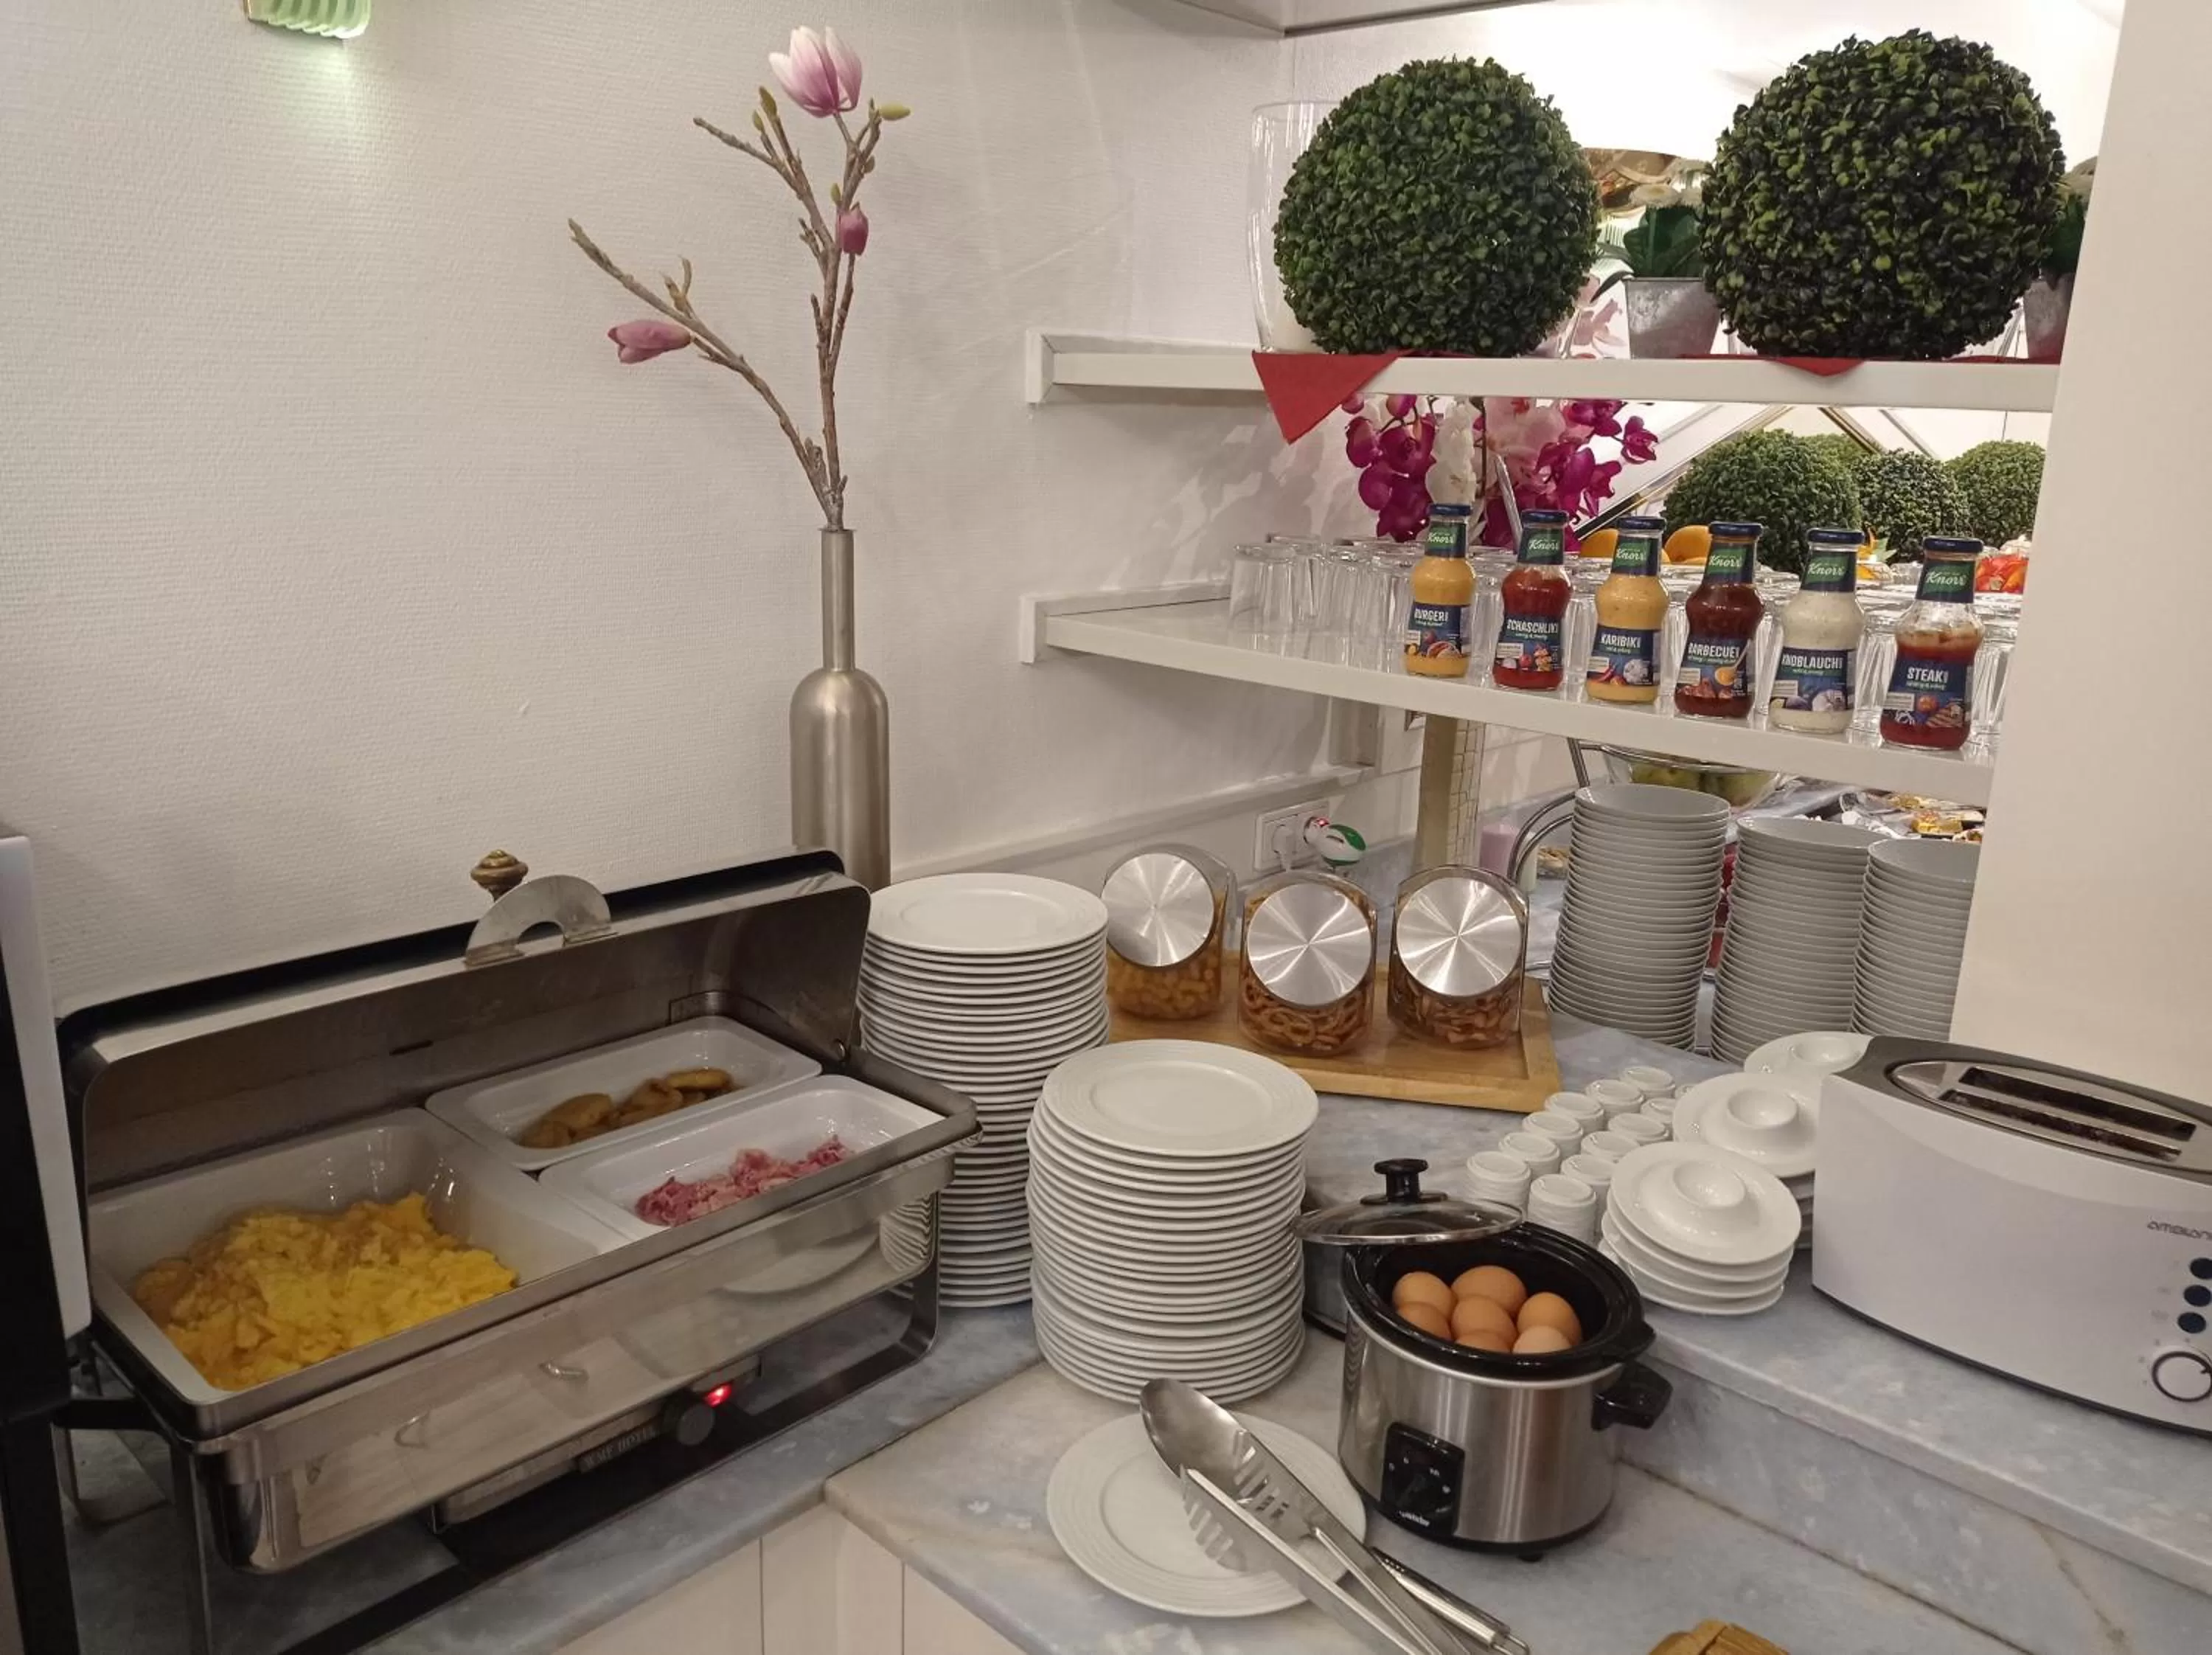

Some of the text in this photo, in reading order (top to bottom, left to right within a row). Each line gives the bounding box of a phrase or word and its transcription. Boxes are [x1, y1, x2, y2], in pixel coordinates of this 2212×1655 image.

[1427, 532, 1455, 544] Knorr
[1528, 539, 1559, 550] Knorr
[1615, 548, 1646, 561] Knorr
[1708, 555, 1742, 567] Knorr
[1808, 563, 1845, 576] Knorr
[1926, 571, 1967, 586] Knorr
